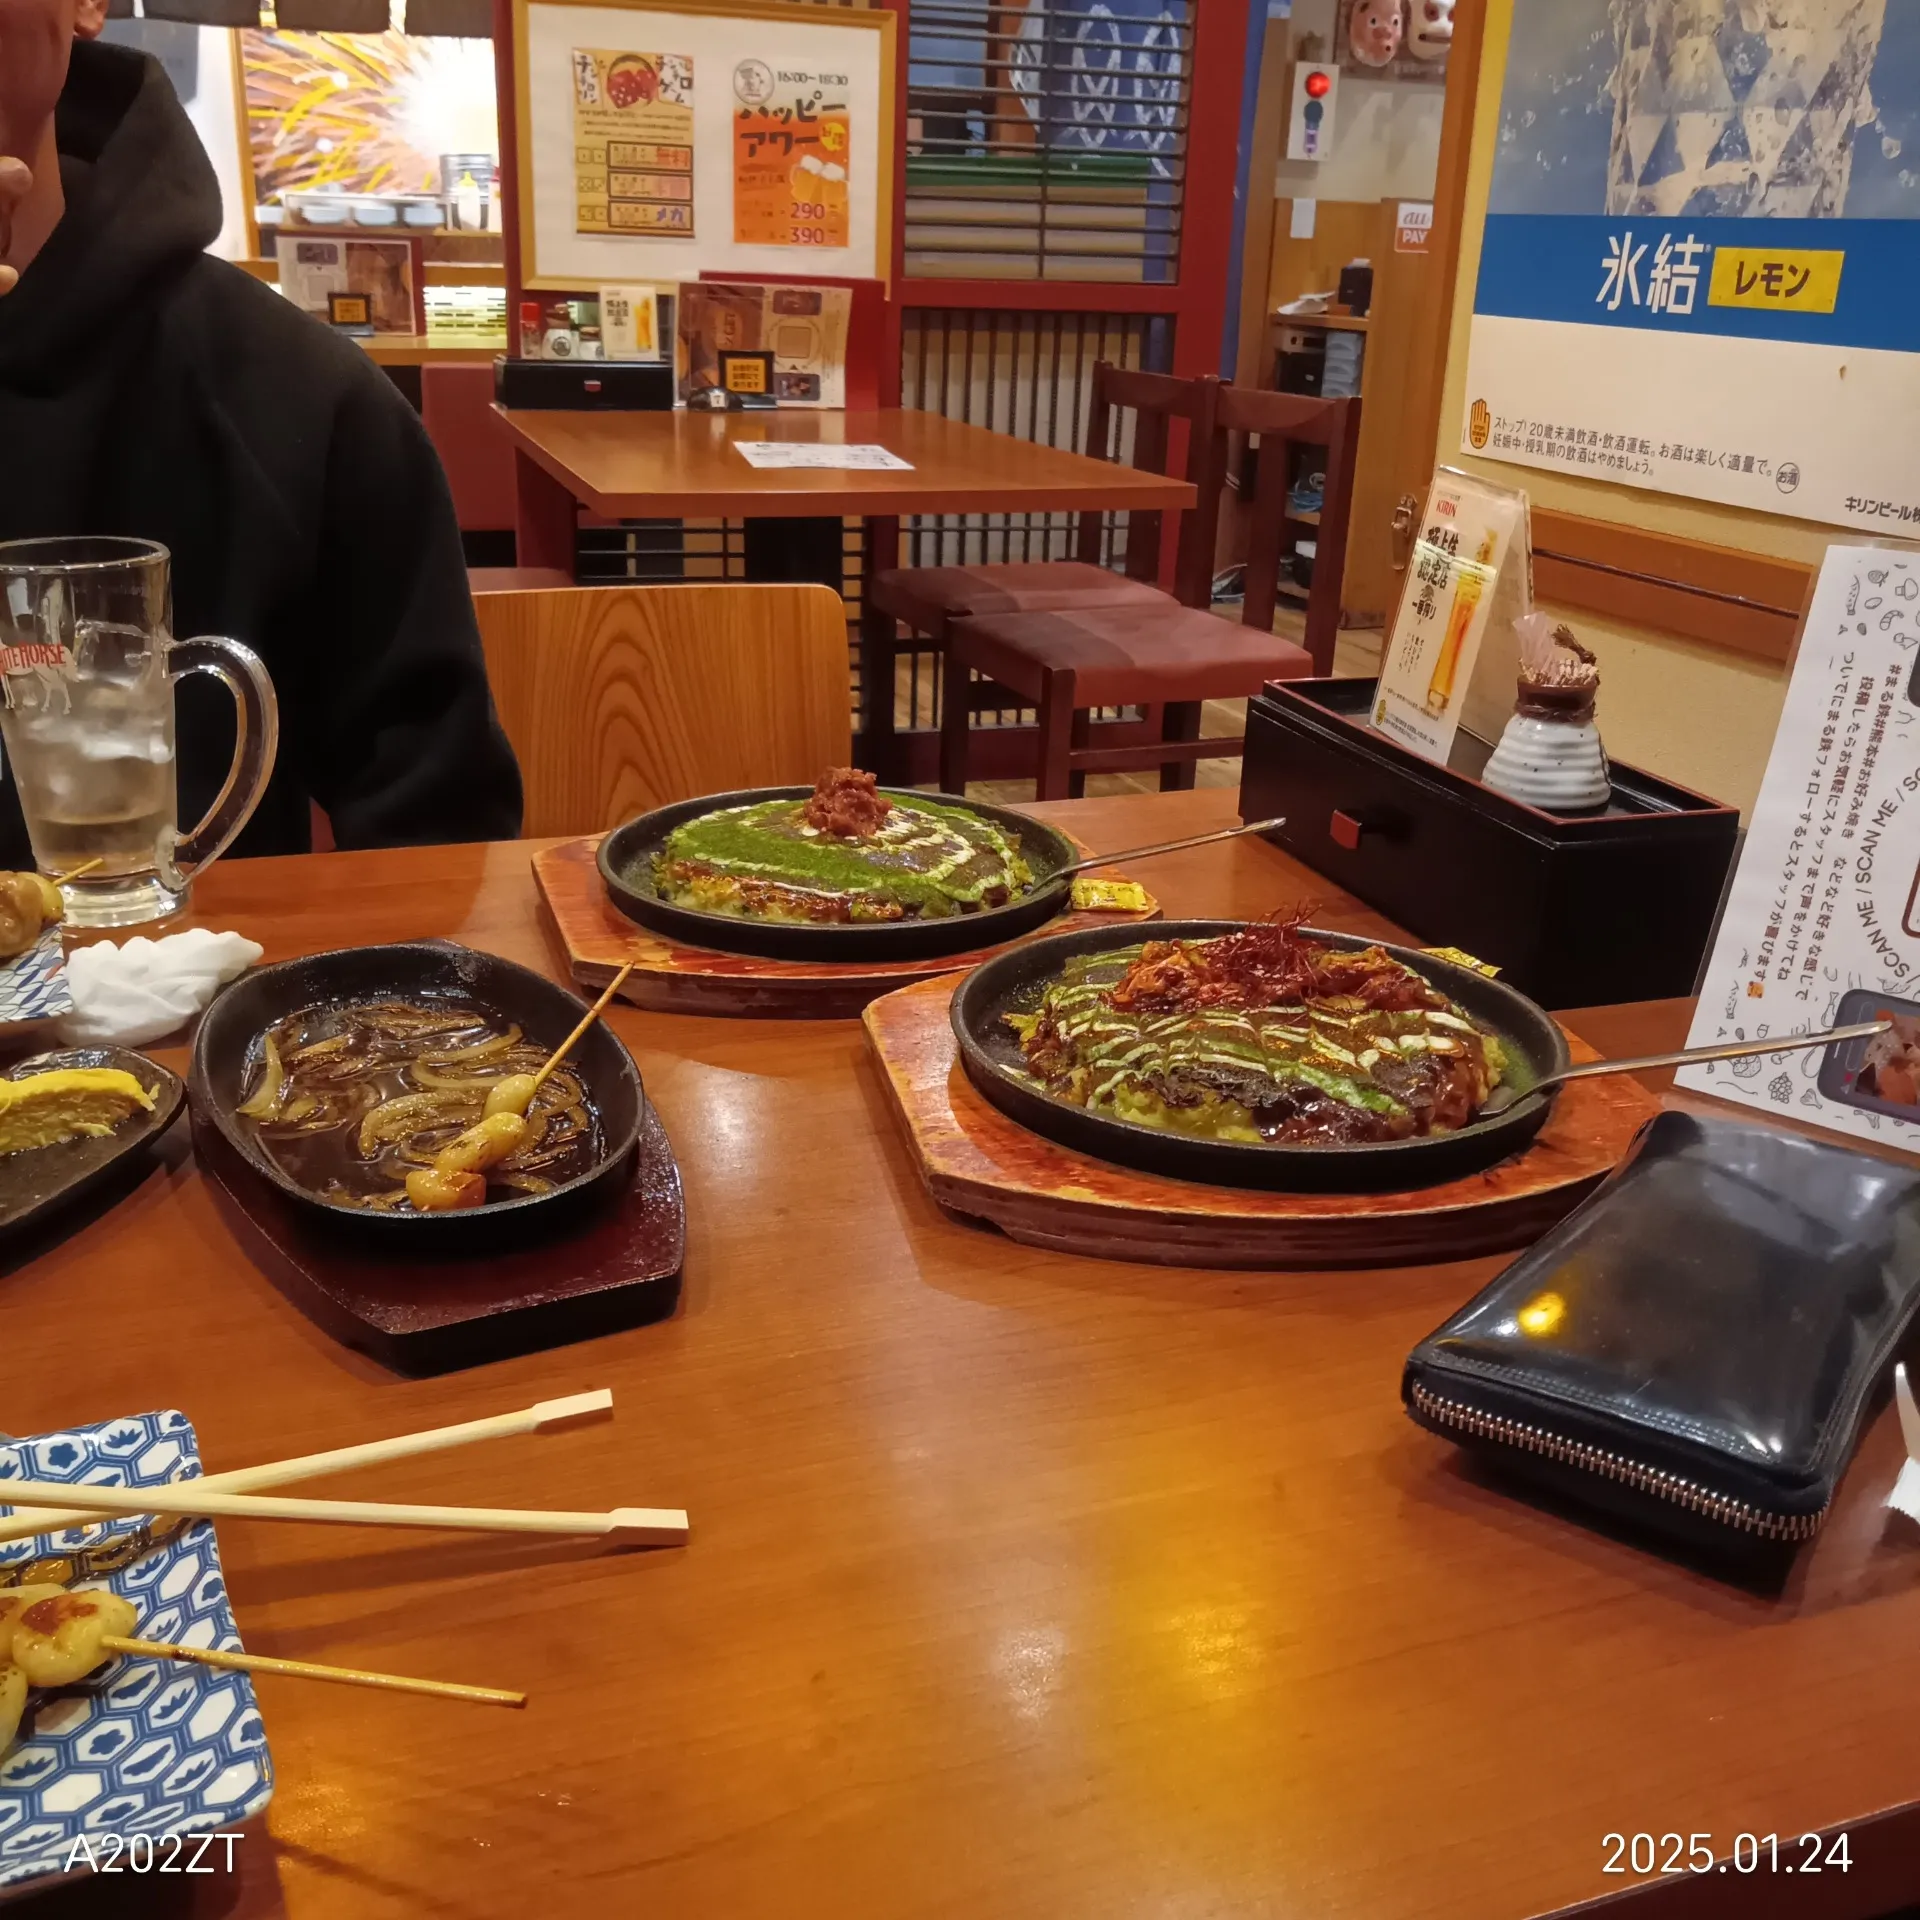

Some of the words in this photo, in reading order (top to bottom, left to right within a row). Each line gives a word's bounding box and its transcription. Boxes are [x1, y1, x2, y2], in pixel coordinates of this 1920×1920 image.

[738, 90, 847, 125] ハッピー
[740, 131, 819, 158] アワー
[790, 202, 825, 220] 290
[1403, 211, 1429, 225] au
[790, 227, 824, 244] 390
[1402, 229, 1428, 244] PAY
[1596, 231, 1705, 315] 氷結
[1734, 260, 1811, 299] レモン
[1436, 499, 1458, 518] KIRIN
[1872, 798, 1899, 828] ME
[1855, 830, 1882, 884] SCAN
[1857, 900, 1879, 928] ME
[1867, 929, 1910, 978] SCAN
